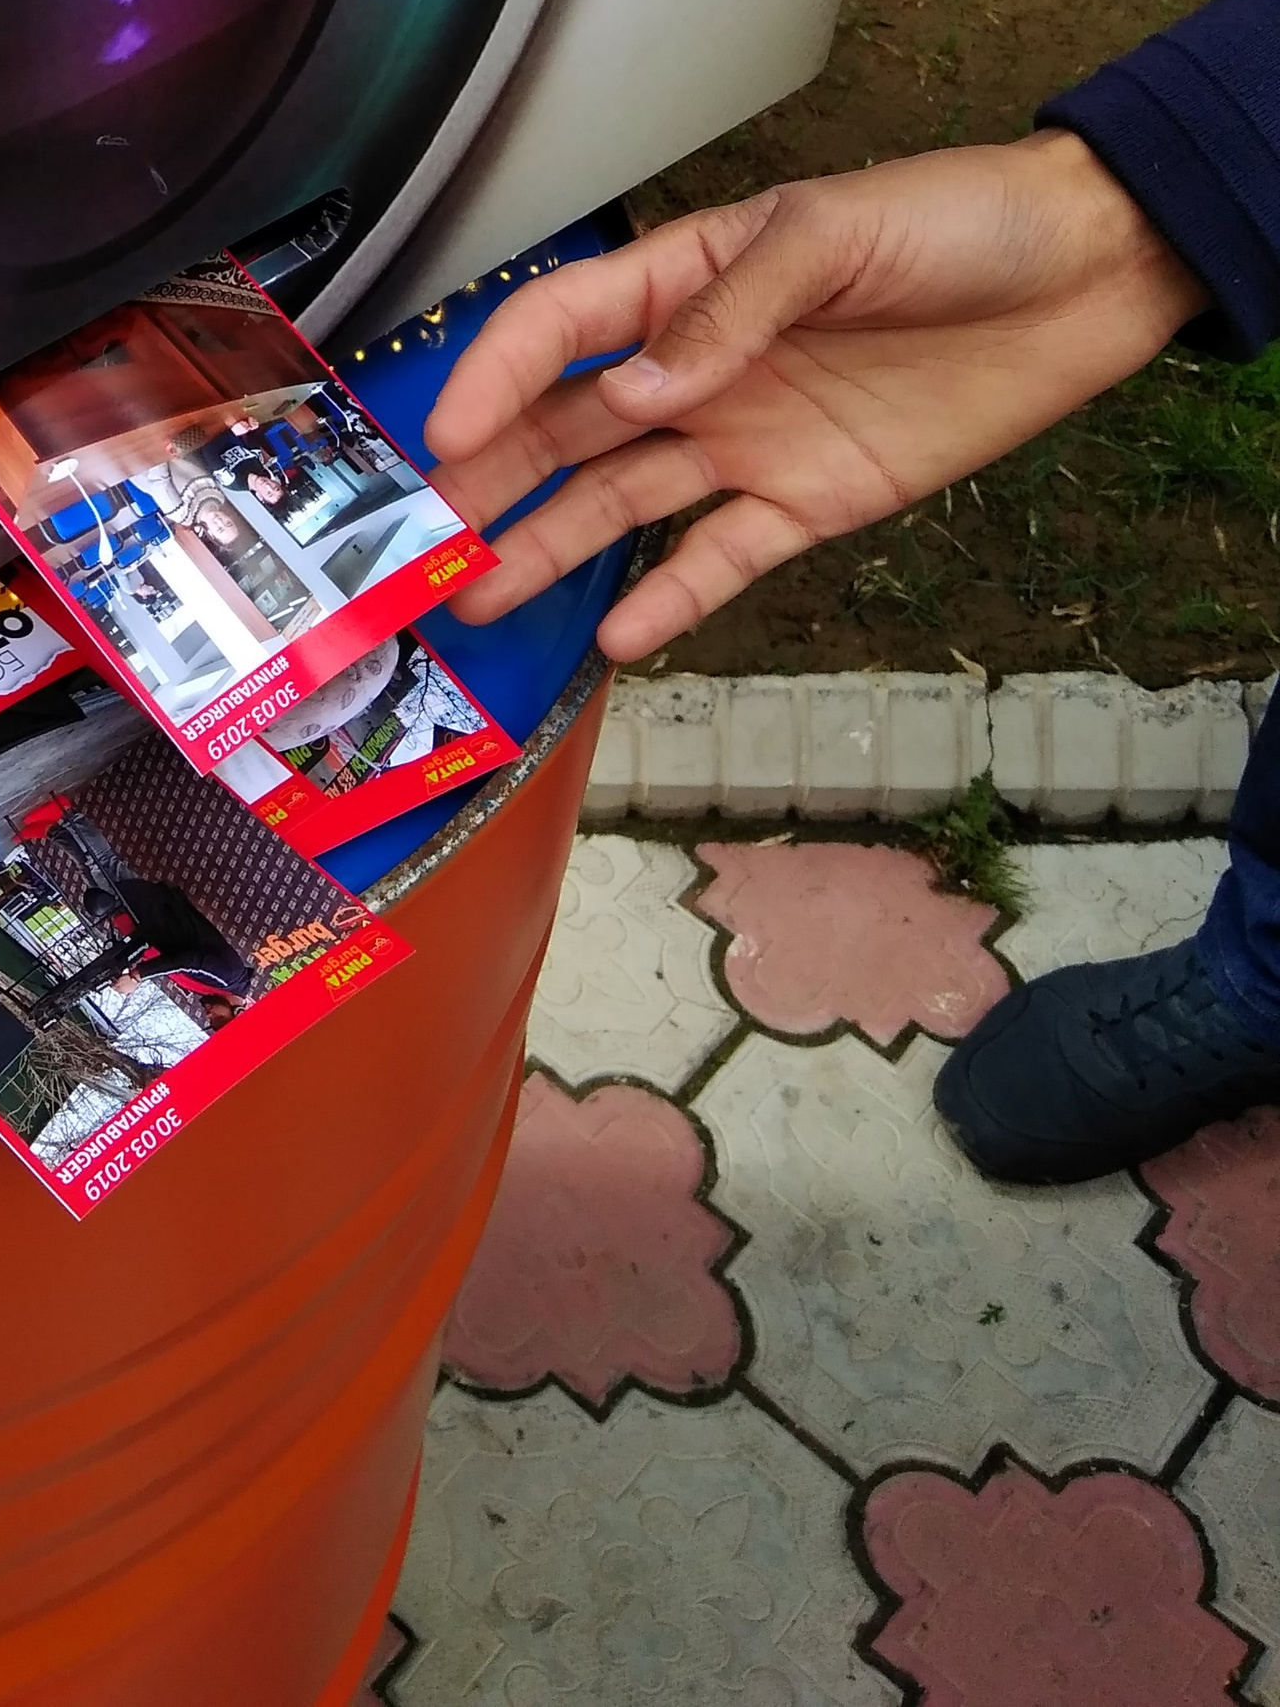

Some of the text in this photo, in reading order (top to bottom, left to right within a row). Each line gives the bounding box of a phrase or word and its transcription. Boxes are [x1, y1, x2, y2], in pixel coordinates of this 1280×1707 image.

[422, 547, 460, 574] burger
[427, 555, 469, 585] PINTA
[180, 655, 290, 742] #PINTABURGER
[207, 681, 300, 761] 30.03.2019
[421, 746, 469, 772] burger
[425, 754, 478, 784] PINTA
[251, 920, 337, 969] burger
[319, 944, 363, 978] burger
[325, 952, 374, 987] PINTA
[56, 1081, 171, 1185] #PINTABURGER
[84, 1107, 183, 1201] 30.03.2019
